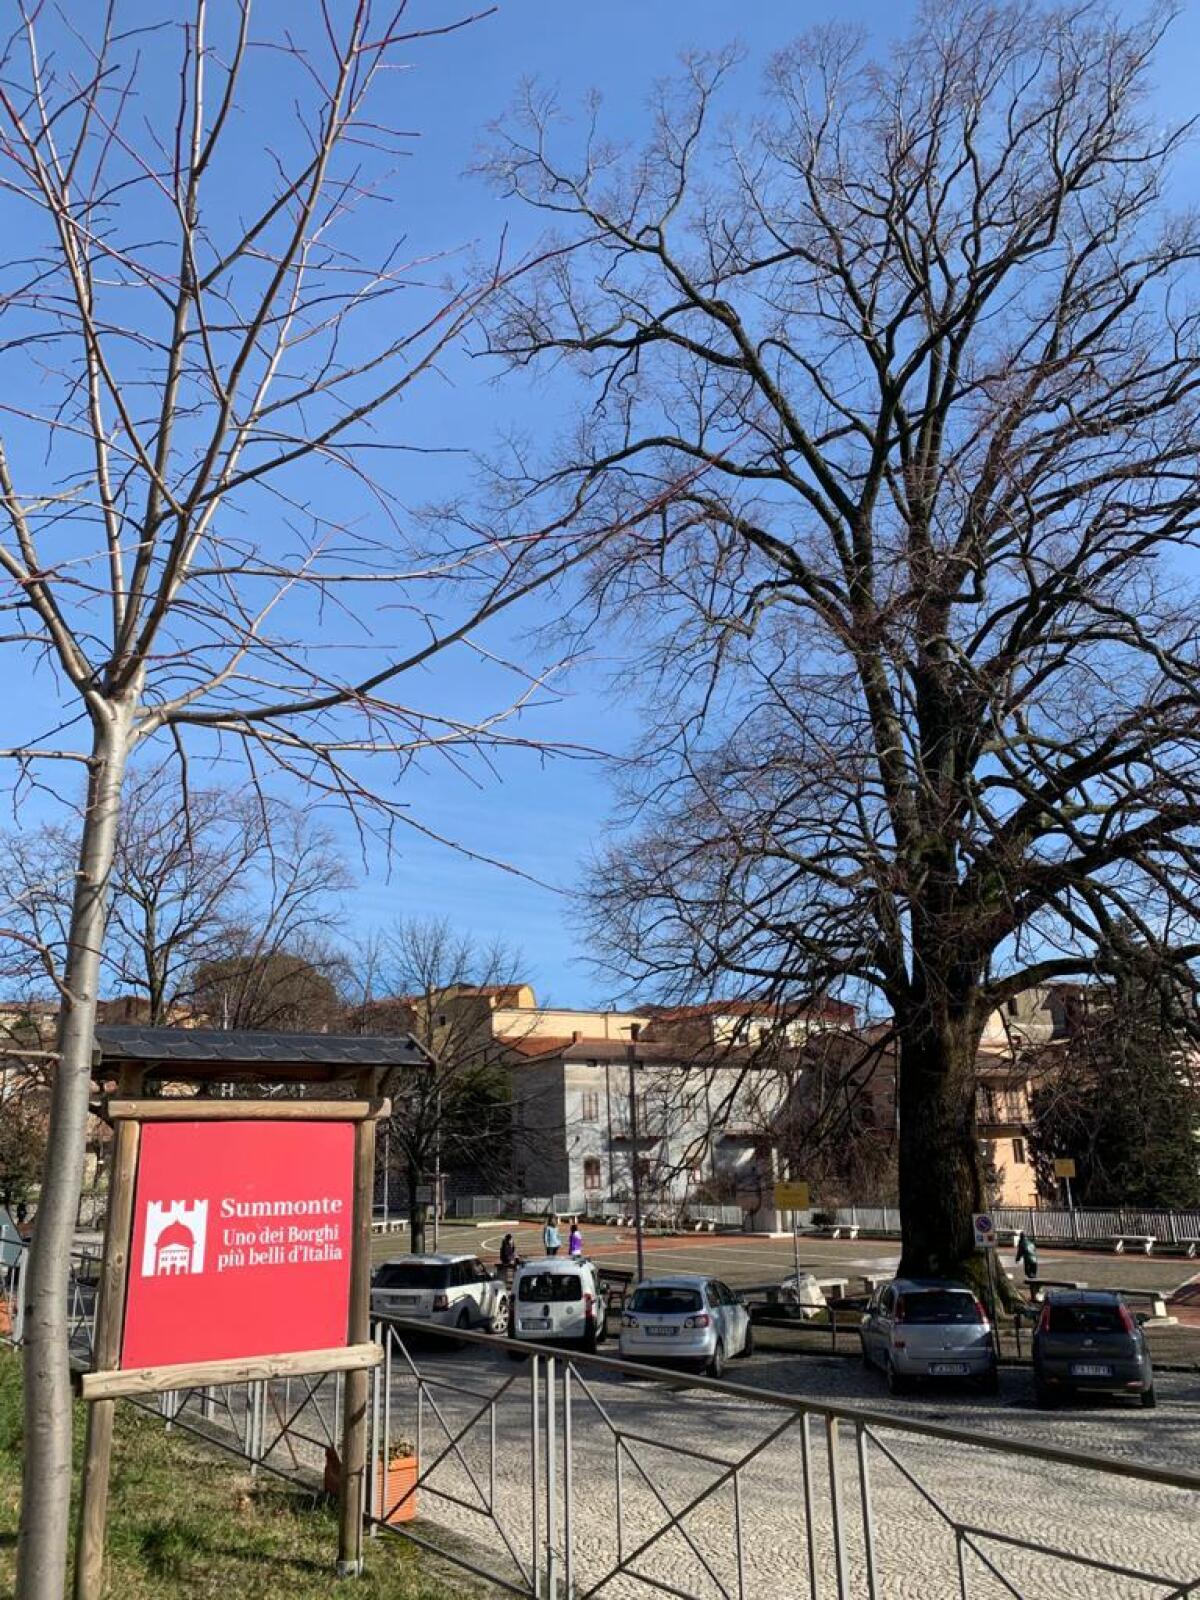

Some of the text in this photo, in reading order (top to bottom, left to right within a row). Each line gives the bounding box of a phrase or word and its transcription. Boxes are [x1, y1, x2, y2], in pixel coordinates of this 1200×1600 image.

[220, 1197, 343, 1218] Summonte
[224, 1224, 339, 1246] Uno dei Borghi
[217, 1244, 342, 1272] più belli d'Italia
